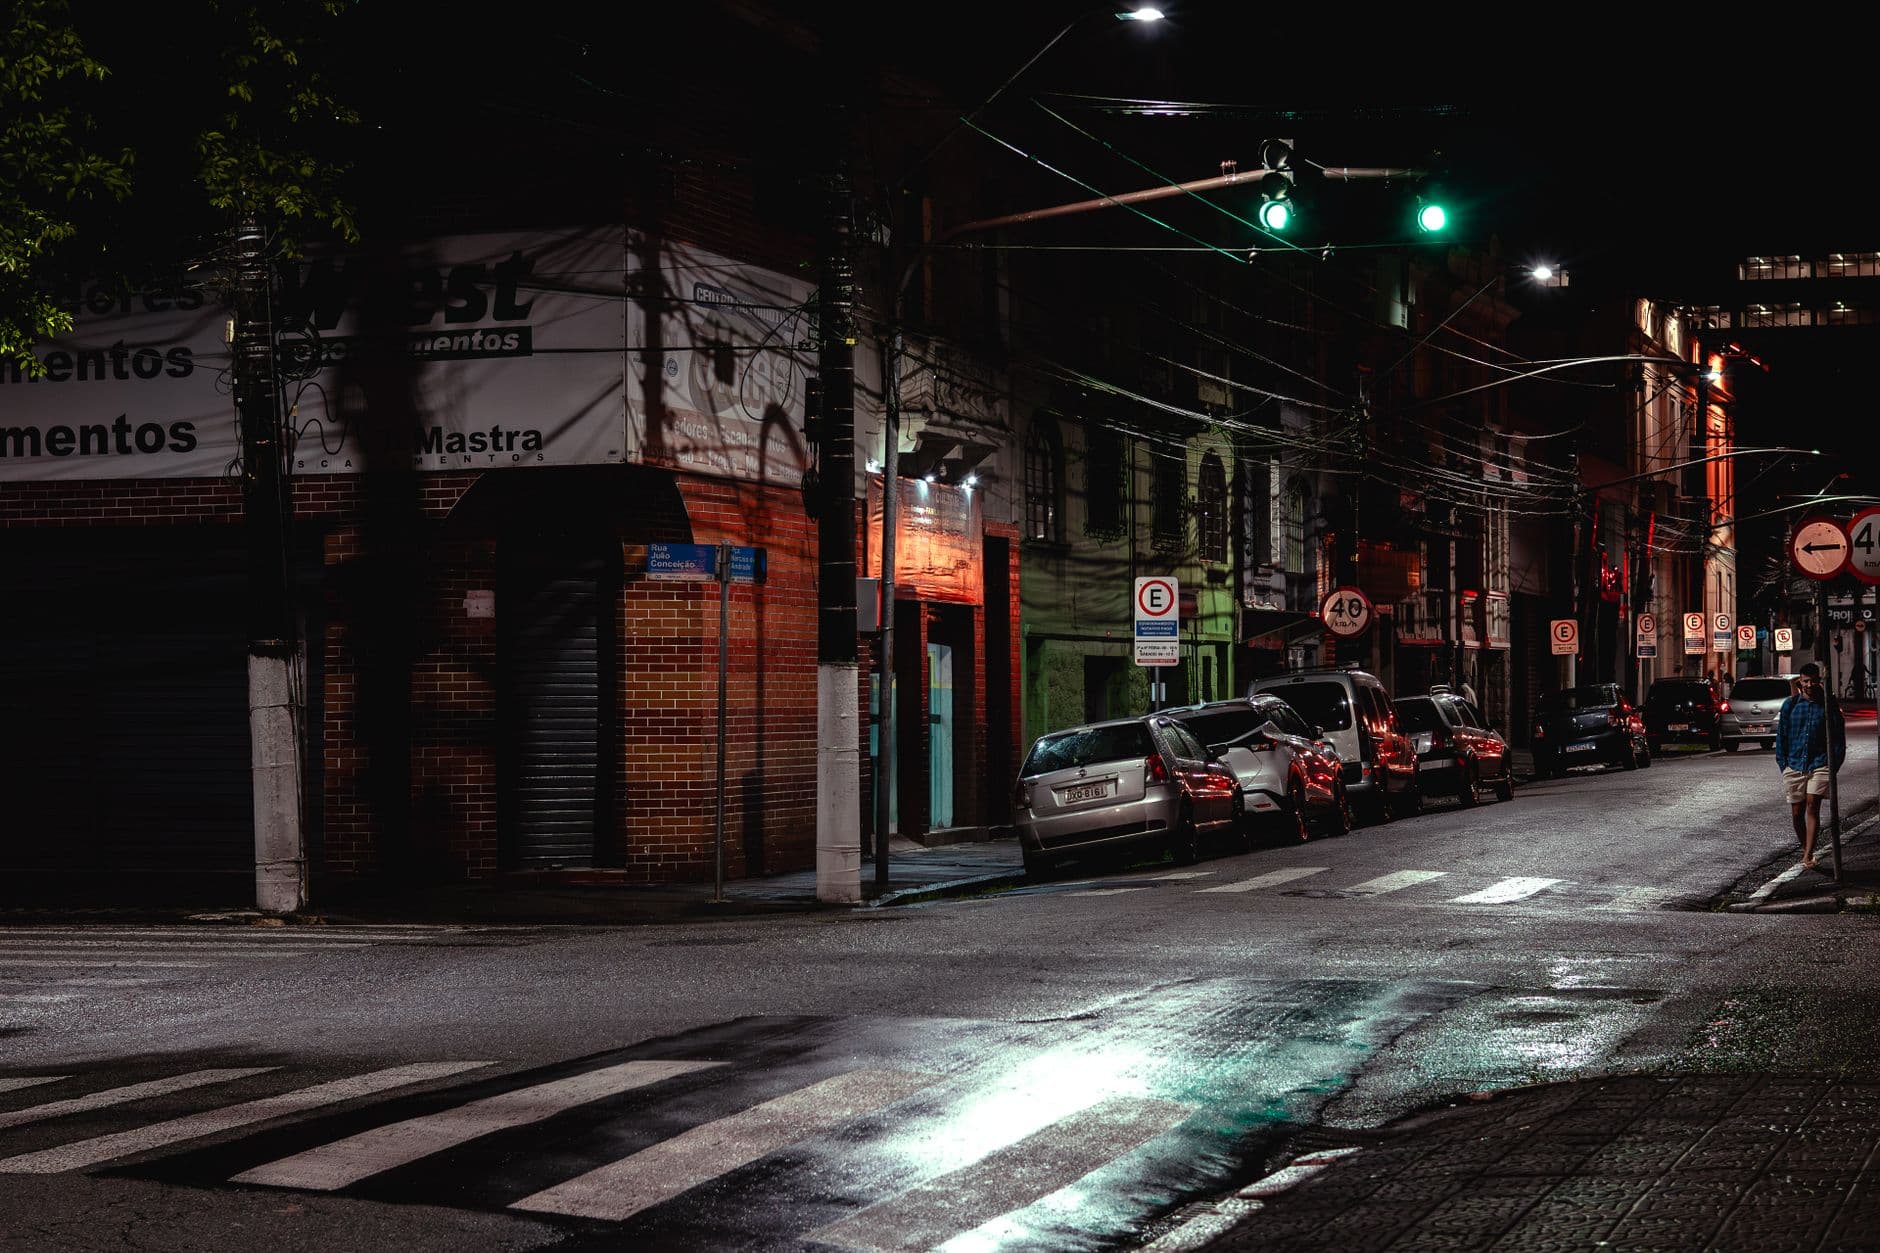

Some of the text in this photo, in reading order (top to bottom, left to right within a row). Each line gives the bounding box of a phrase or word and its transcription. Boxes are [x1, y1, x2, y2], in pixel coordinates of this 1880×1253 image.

[416, 425, 544, 455] Mastra
[1854, 523, 1880, 554] 4
[651, 544, 668, 552] Rua
[1150, 589, 1162, 607] E
[1329, 598, 1363, 618] 40
[1335, 620, 1357, 628] km/h
[1644, 620, 1651, 629] E
[1691, 617, 1698, 627] E
[1720, 618, 1726, 627] E
[1561, 626, 1569, 638] E
